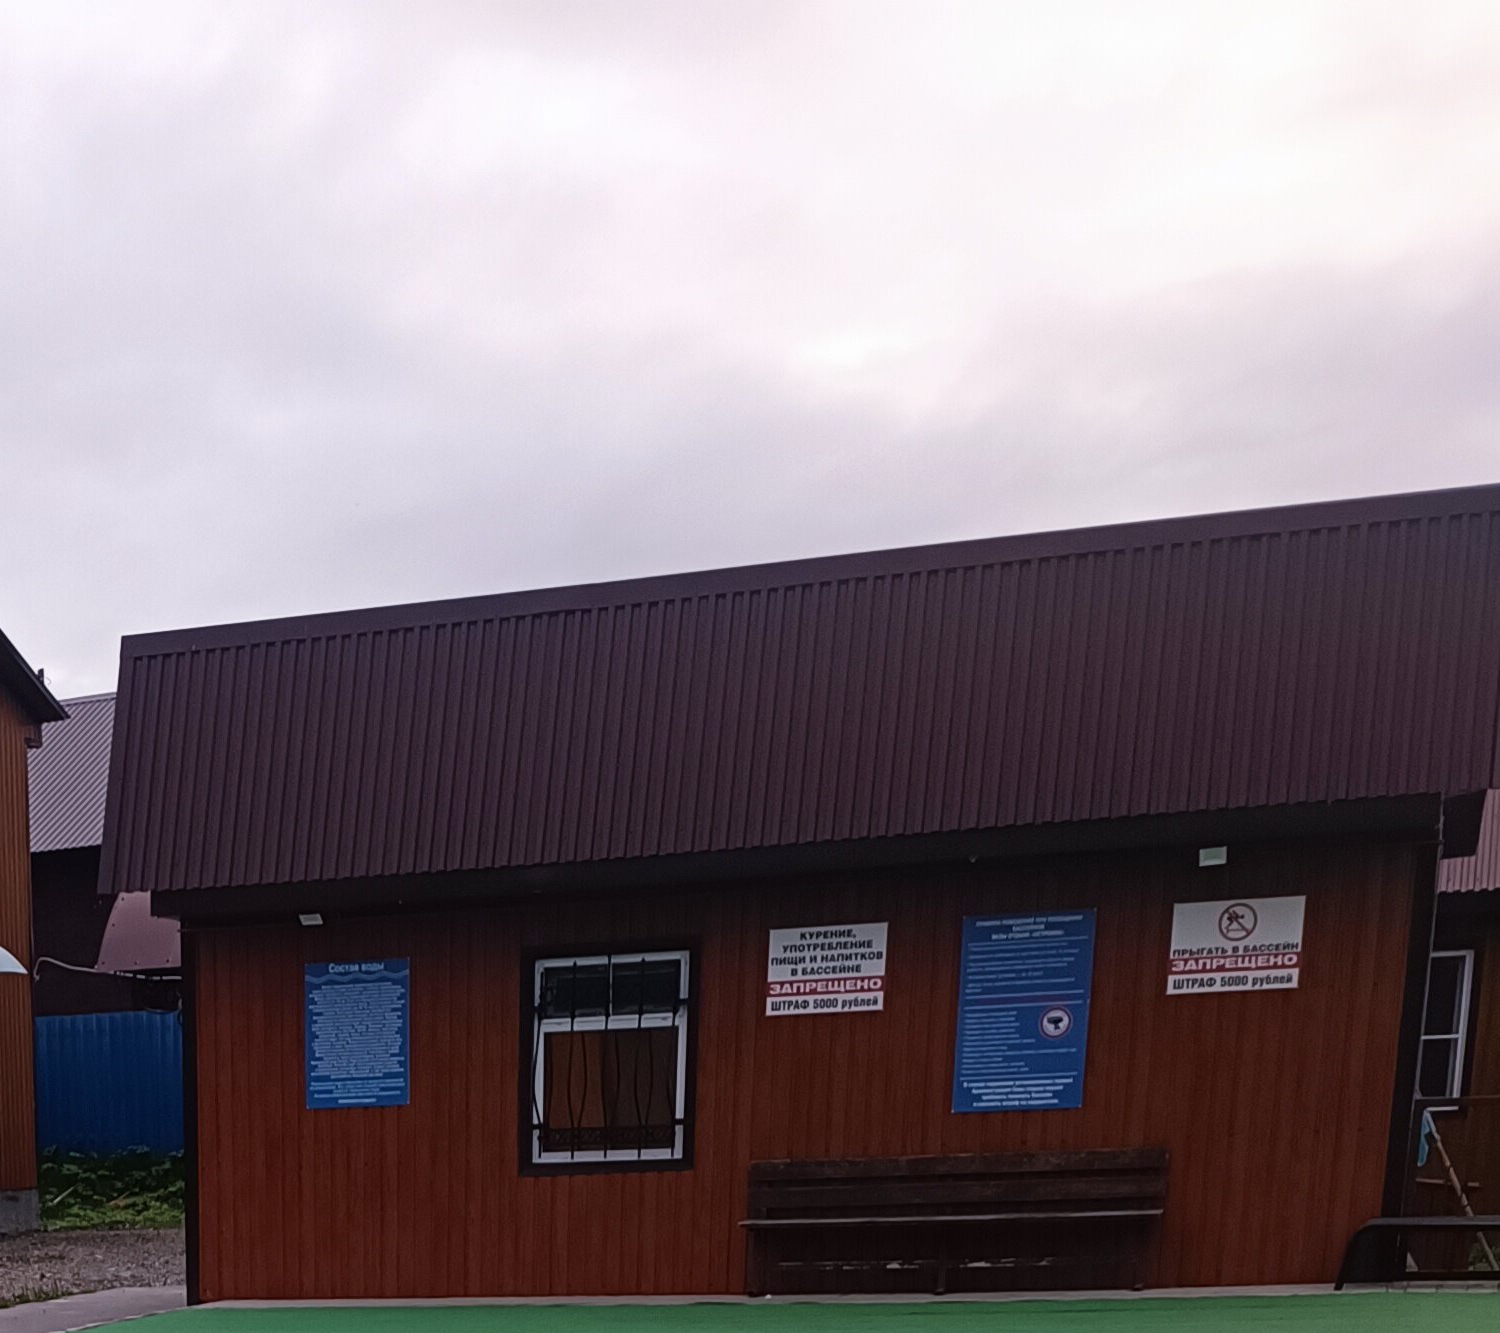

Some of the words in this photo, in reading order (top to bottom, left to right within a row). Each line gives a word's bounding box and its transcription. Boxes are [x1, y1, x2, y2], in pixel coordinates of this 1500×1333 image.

[800, 929, 856, 941] КУРЕНИЕ,
[782, 939, 873, 954] УПОТРЕБЛЕНИЕ
[1172, 947, 1228, 957] ПРЫГАТЬ
[1232, 946, 1239, 954] В
[1243, 942, 1299, 954] БАССЕЙН
[771, 956, 806, 966] ПИЩИ
[809, 955, 817, 964] И
[821, 951, 883, 963] НАПИТКОВ
[1171, 954, 1298, 971] ЗАПРЕЩЕНО
[791, 968, 798, 977] В
[801, 963, 862, 976] БАССЕЙНЕ
[769, 978, 882, 995] ЗАПРЕЩЕНО
[1172, 977, 1217, 990] ШТРАФ
[1220, 975, 1248, 988] 5000
[1252, 973, 1293, 988] рублей
[771, 1000, 810, 1011] ШТРАФ
[813, 998, 838, 1009] 5000
[841, 996, 879, 1009] рублей
